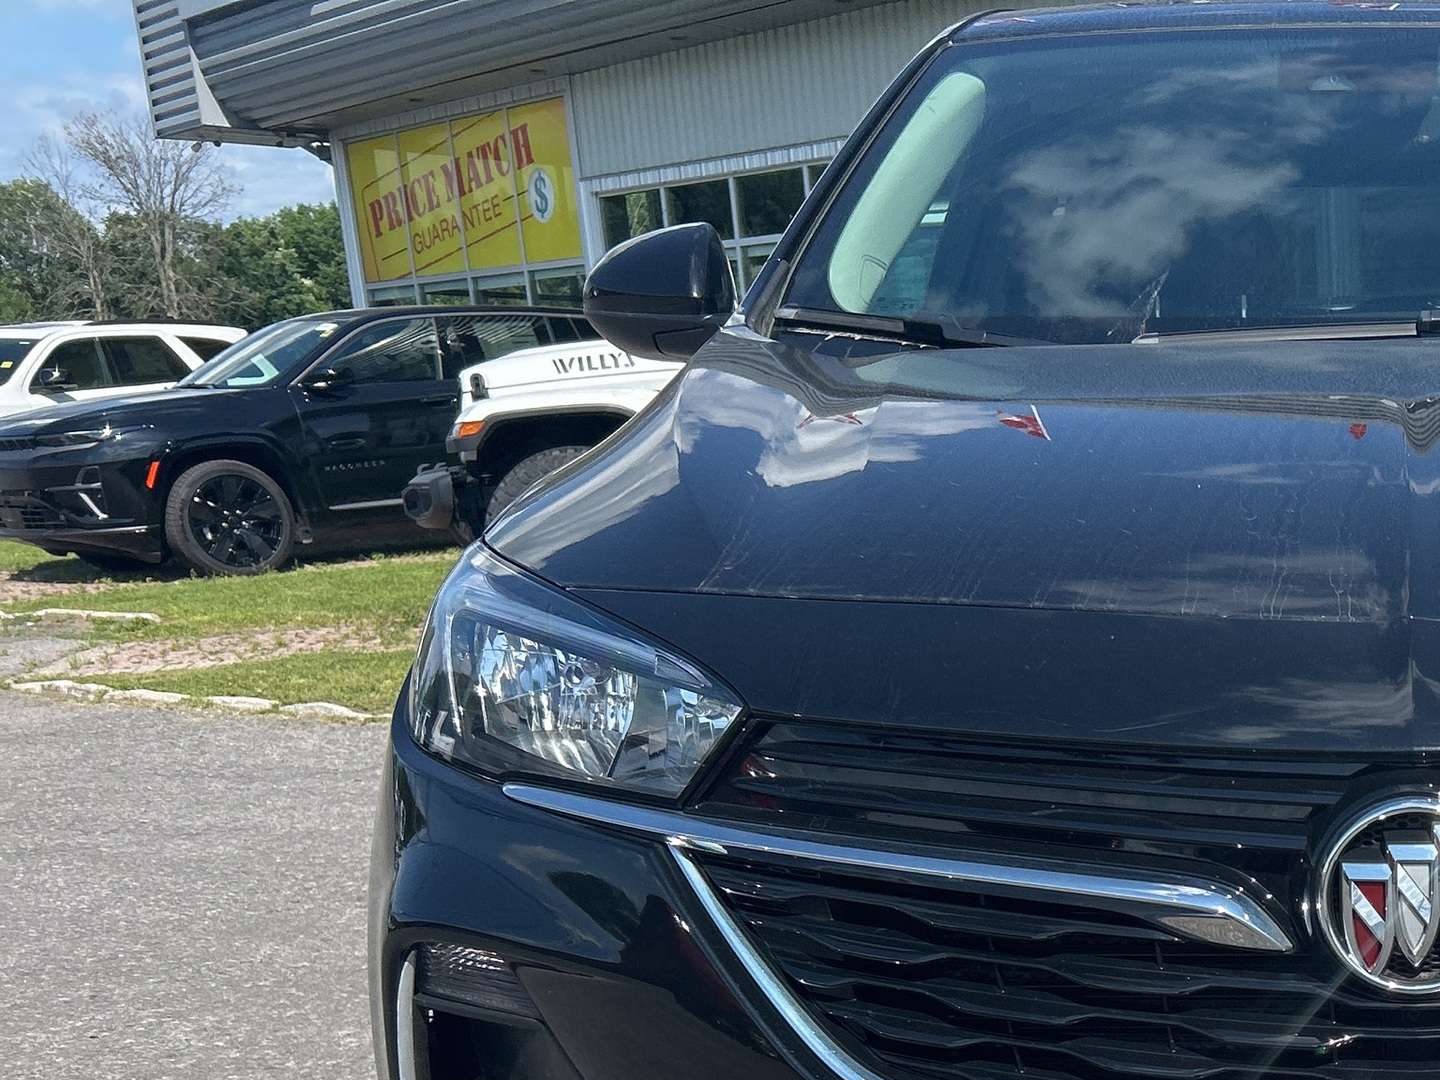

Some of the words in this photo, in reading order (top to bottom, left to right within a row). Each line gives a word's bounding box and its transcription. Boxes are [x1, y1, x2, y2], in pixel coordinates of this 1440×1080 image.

[368, 169, 441, 238] PRICE
[440, 123, 535, 202] MATCH
[412, 194, 503, 254] GUARANTEE
